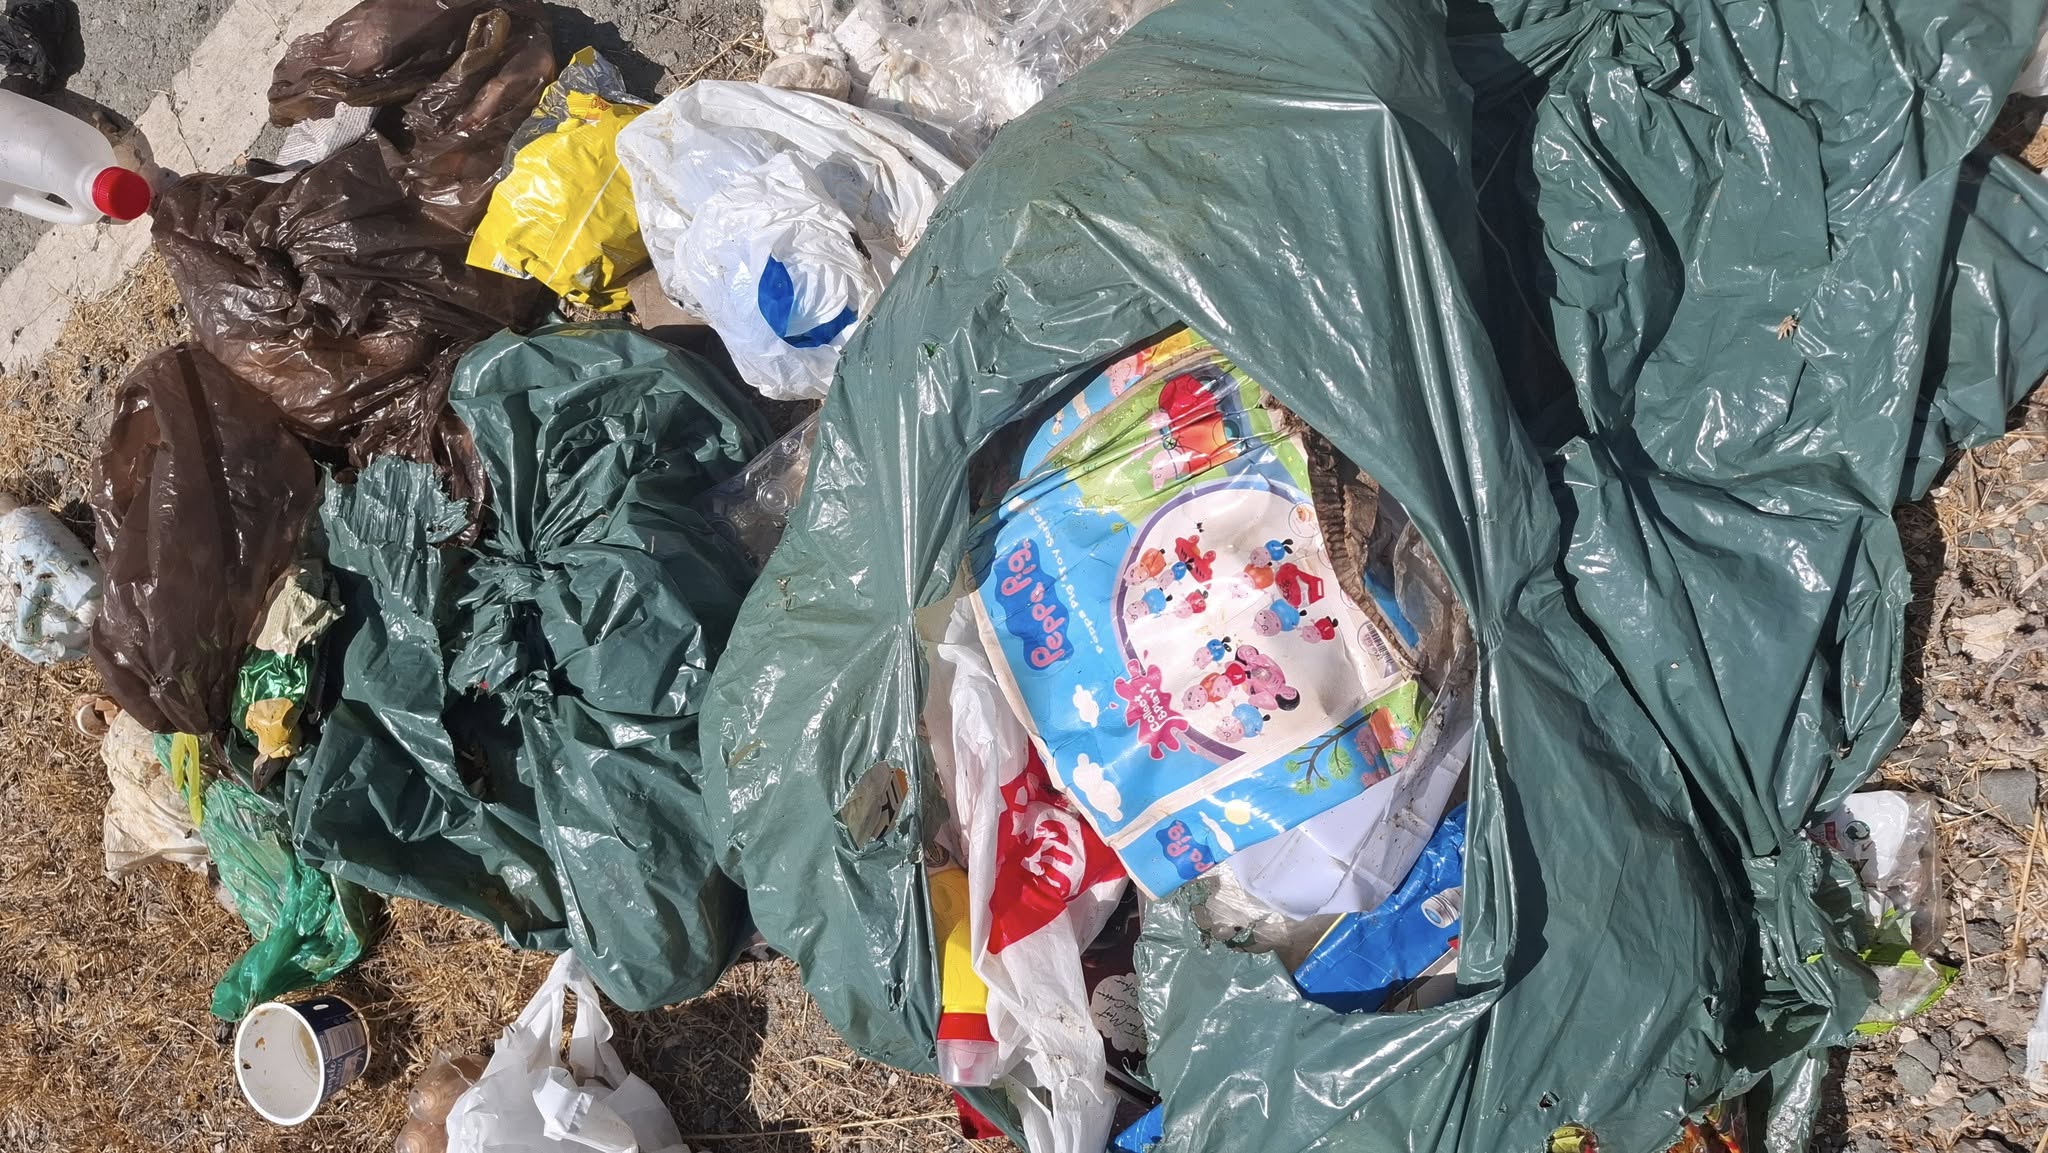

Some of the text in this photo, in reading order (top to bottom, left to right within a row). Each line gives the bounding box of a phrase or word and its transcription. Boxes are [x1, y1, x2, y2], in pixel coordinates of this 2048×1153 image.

[1030, 581, 1066, 668] Peppa
[1134, 694, 1160, 732] Collect
[1167, 825, 1191, 857] Pig
[1096, 991, 1126, 1008] Coffee
[1096, 1006, 1127, 1027] Most
[1124, 1022, 1144, 1037] The
